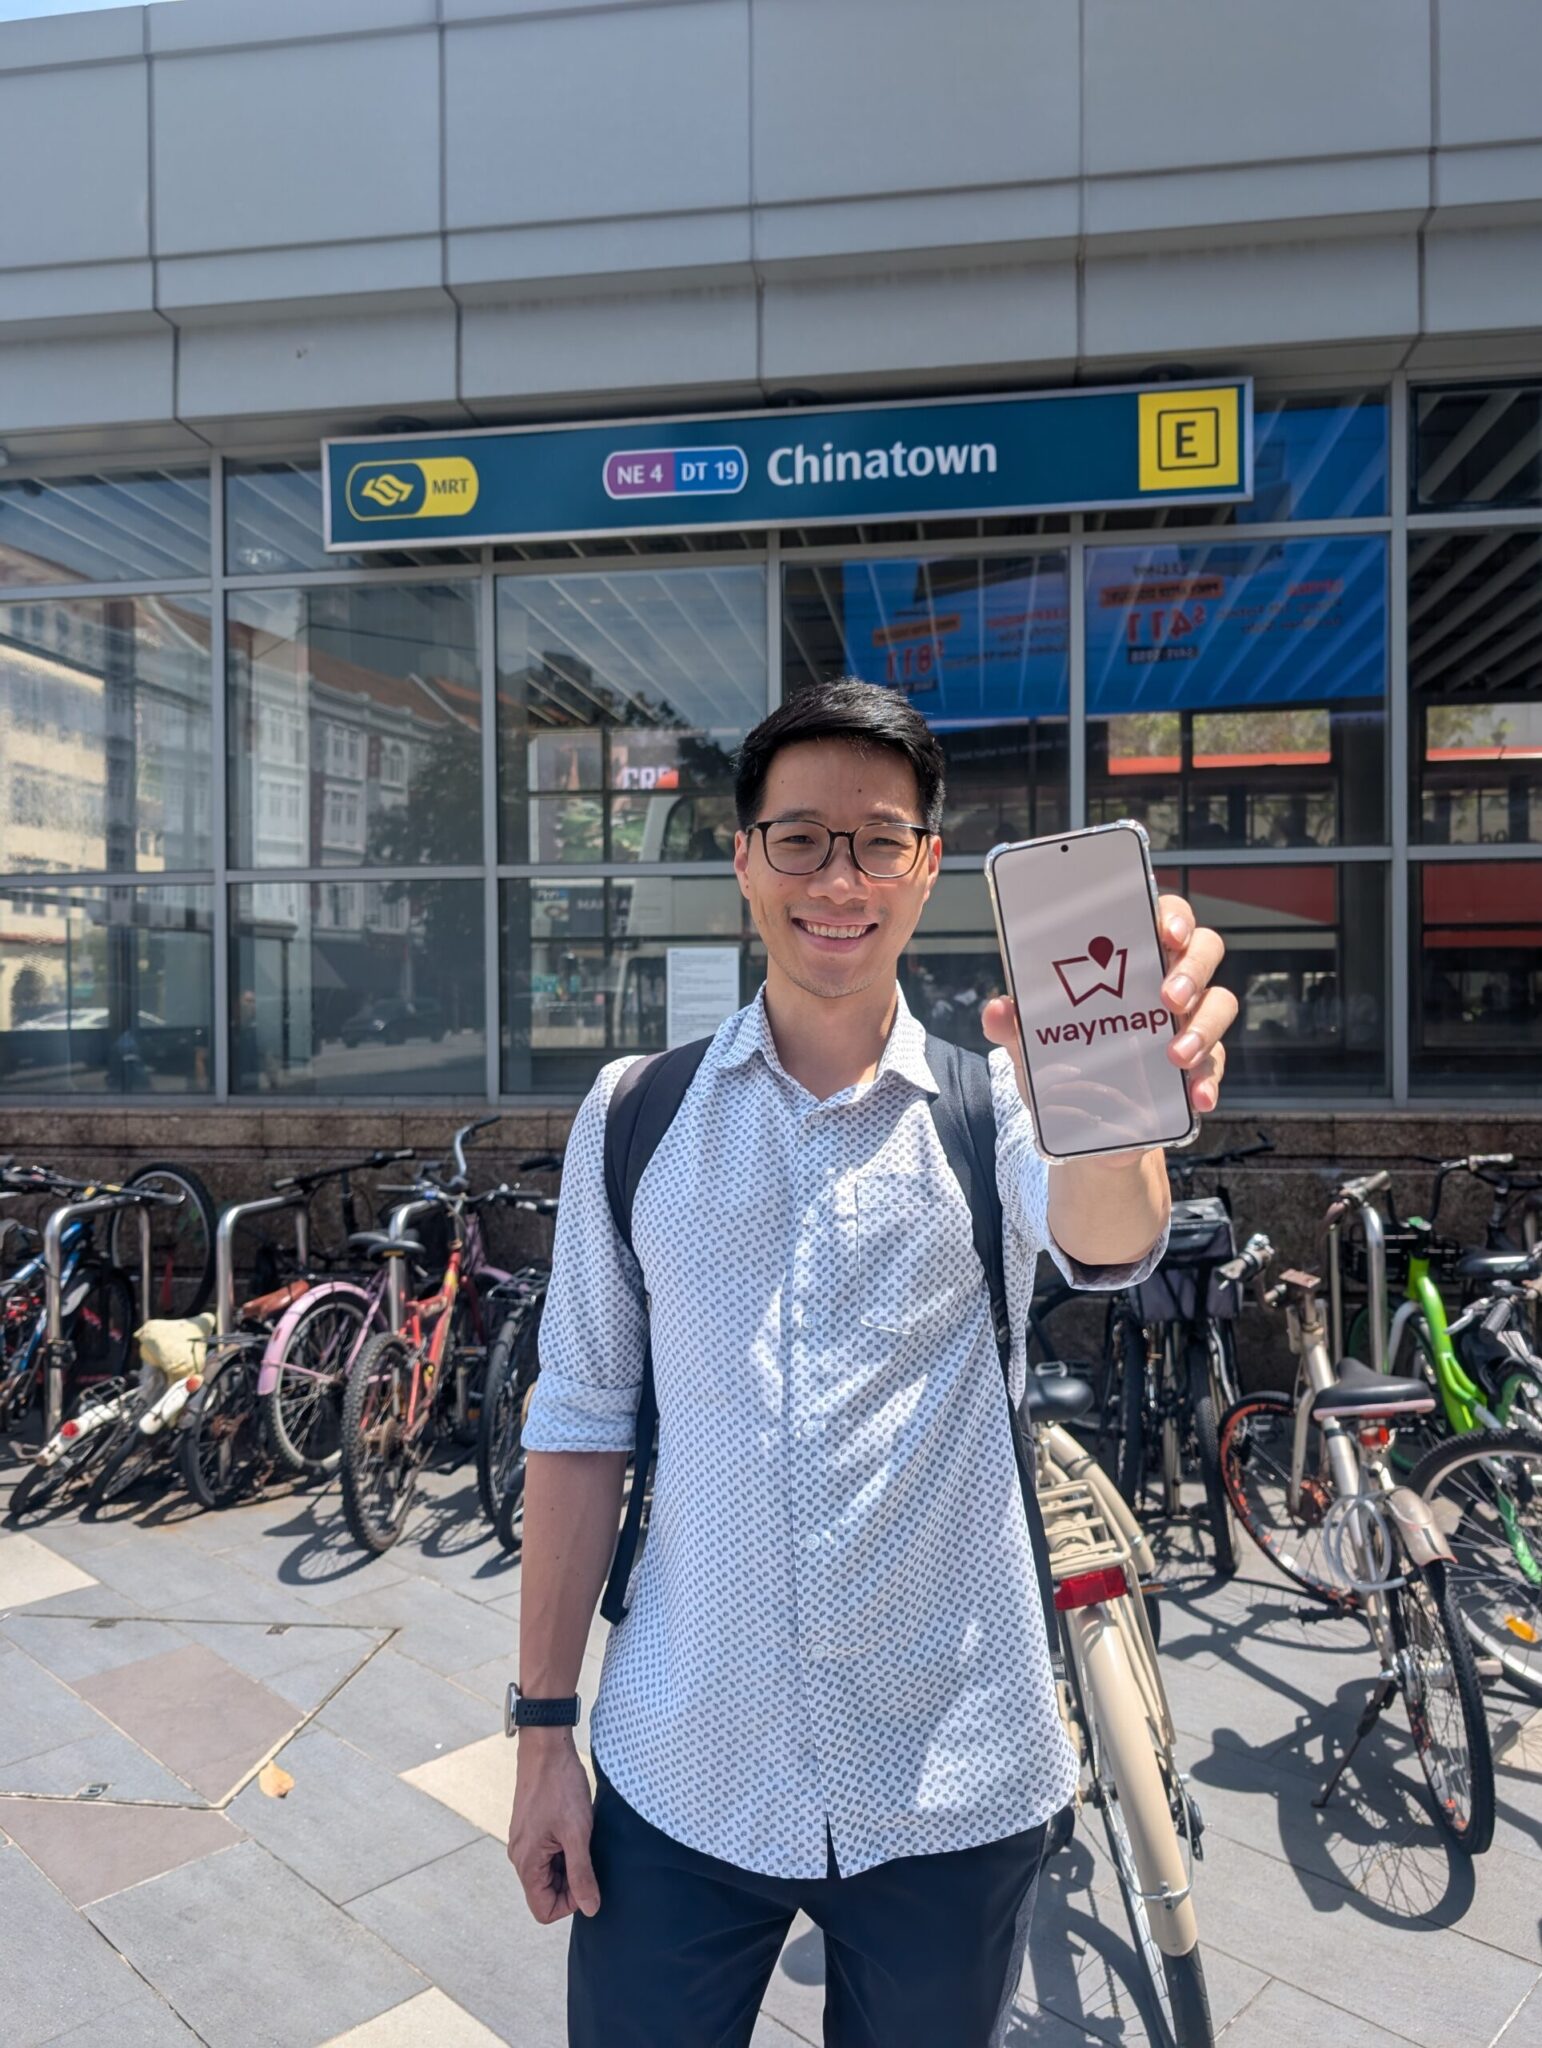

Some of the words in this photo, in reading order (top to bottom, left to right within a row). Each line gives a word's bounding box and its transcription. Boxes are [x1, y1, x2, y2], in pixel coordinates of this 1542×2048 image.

[1175, 420, 1197, 459] E
[617, 464, 645, 485] NE
[649, 463, 663, 483] 4
[681, 462, 708, 481] DT
[714, 460, 739, 480] 19
[767, 441, 998, 486] Chinatown
[432, 477, 469, 495] MRT
[1035, 1008, 1169, 1046] waymap
